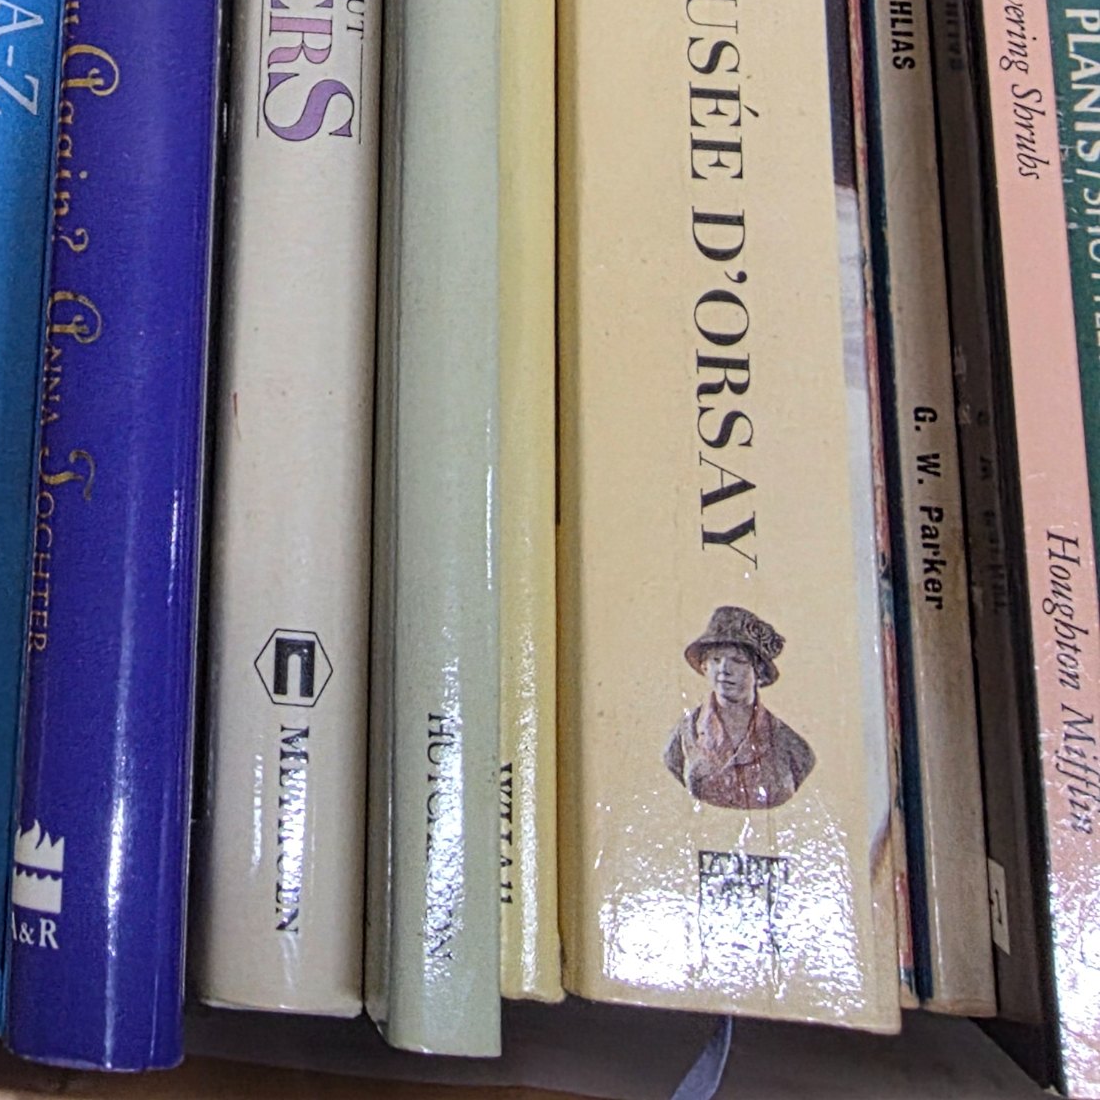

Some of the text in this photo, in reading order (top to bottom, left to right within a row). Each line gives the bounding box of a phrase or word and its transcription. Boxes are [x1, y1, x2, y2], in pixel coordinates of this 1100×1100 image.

[1011, 83, 1051, 181] Shrubs
[691, 205, 758, 570] D'ORSAY
[28, 447, 95, 653] TOCHTER
[913, 405, 947, 610] G. W. Parker
[1043, 530, 1100, 835] Houghton Mifflin
